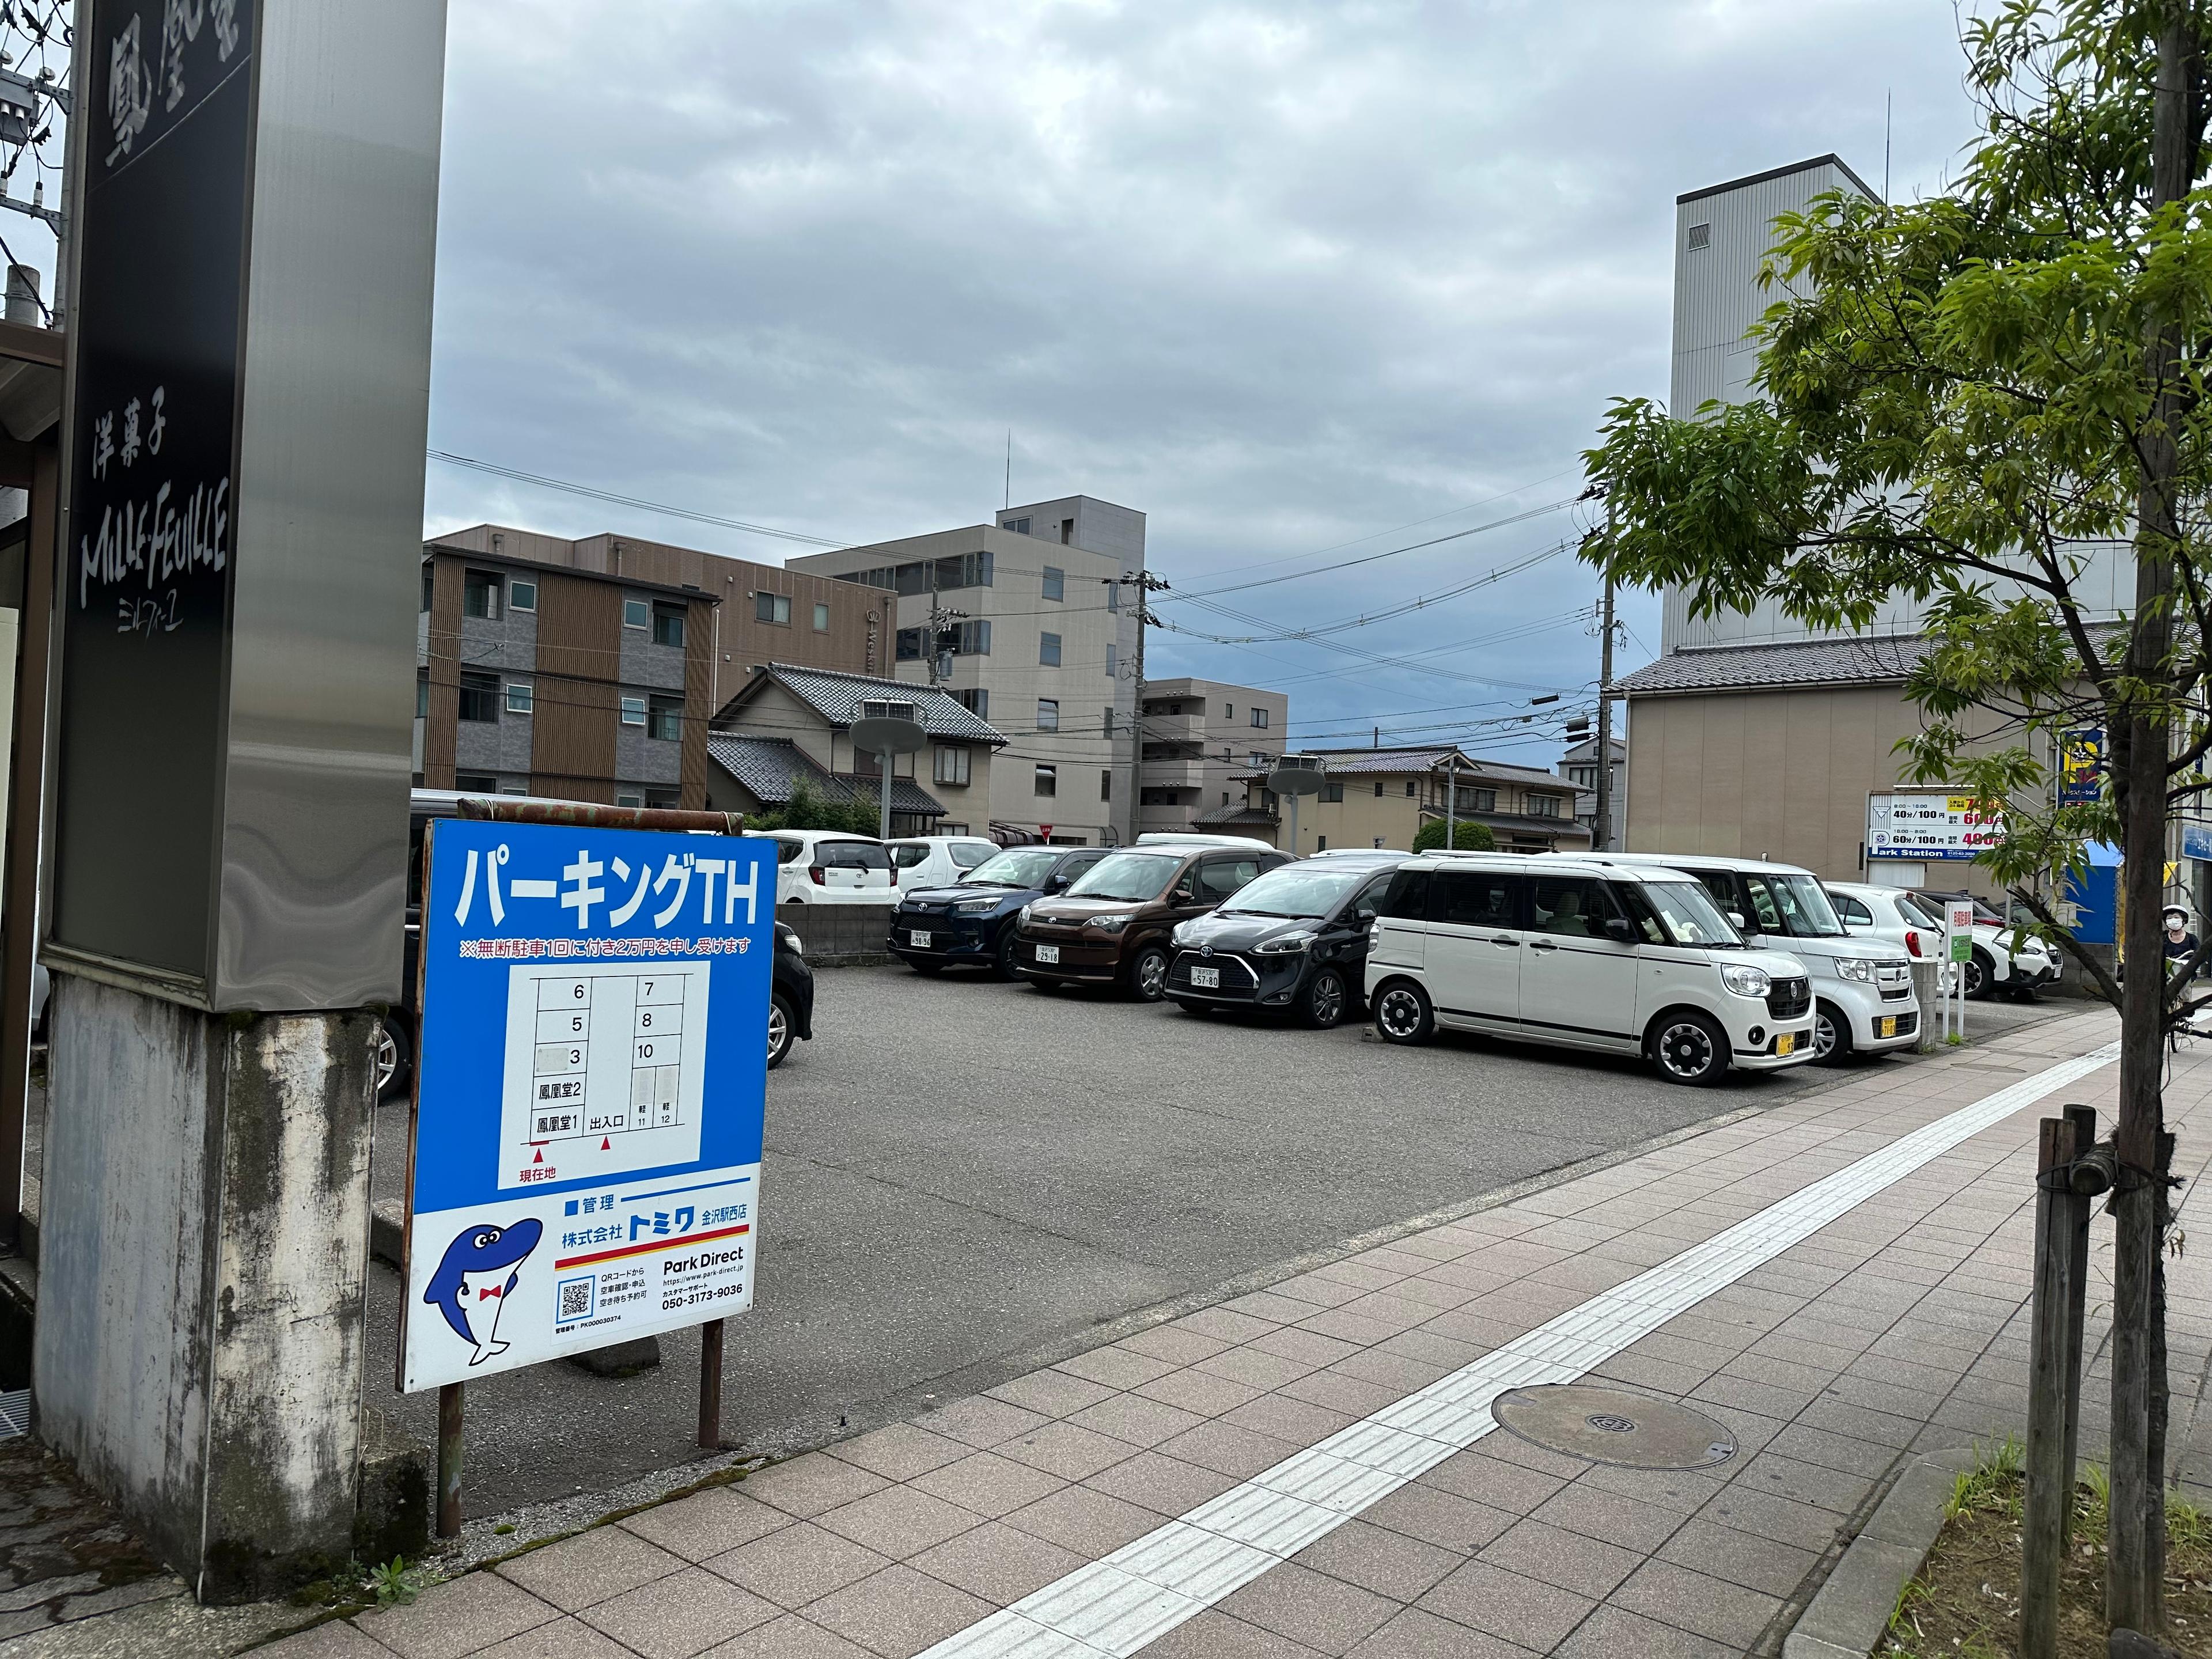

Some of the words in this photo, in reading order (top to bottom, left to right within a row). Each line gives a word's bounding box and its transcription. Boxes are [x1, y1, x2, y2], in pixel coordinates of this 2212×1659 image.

[93, 386, 166, 482] 洋菓子
[1901, 849, 1944, 857] Station
[454, 843, 759, 930] パーキングTH
[574, 984, 584, 999] 6
[645, 982, 654, 996] 7
[572, 1017, 582, 1032] 5
[642, 1013, 652, 1027] 8
[570, 1050, 581, 1064] 3
[638, 1044, 653, 1059] 10
[539, 1081, 581, 1100] 鳳凰堂2
[537, 1115, 578, 1133] 鳳凰堂1
[589, 1115, 624, 1130] 出入口
[638, 1118, 645, 1126] 11
[661, 1115, 670, 1123] 12
[519, 1166, 556, 1183] 現在地
[562, 1224, 623, 1249] 株式会社
[628, 1205, 695, 1241] トミワ
[702, 1203, 747, 1226] 金沢駅西店
[664, 1255, 698, 1275] Park
[700, 1246, 744, 1268] Direct
[601, 1267, 645, 1282] QRコードから
[662, 1263, 744, 1287] https://www.park-direct.jp
[662, 1282, 708, 1298] カスタマーサポート
[662, 1283, 743, 1310] 050-3173-9036
[599, 1290, 647, 1308] 空き待ち予約可
